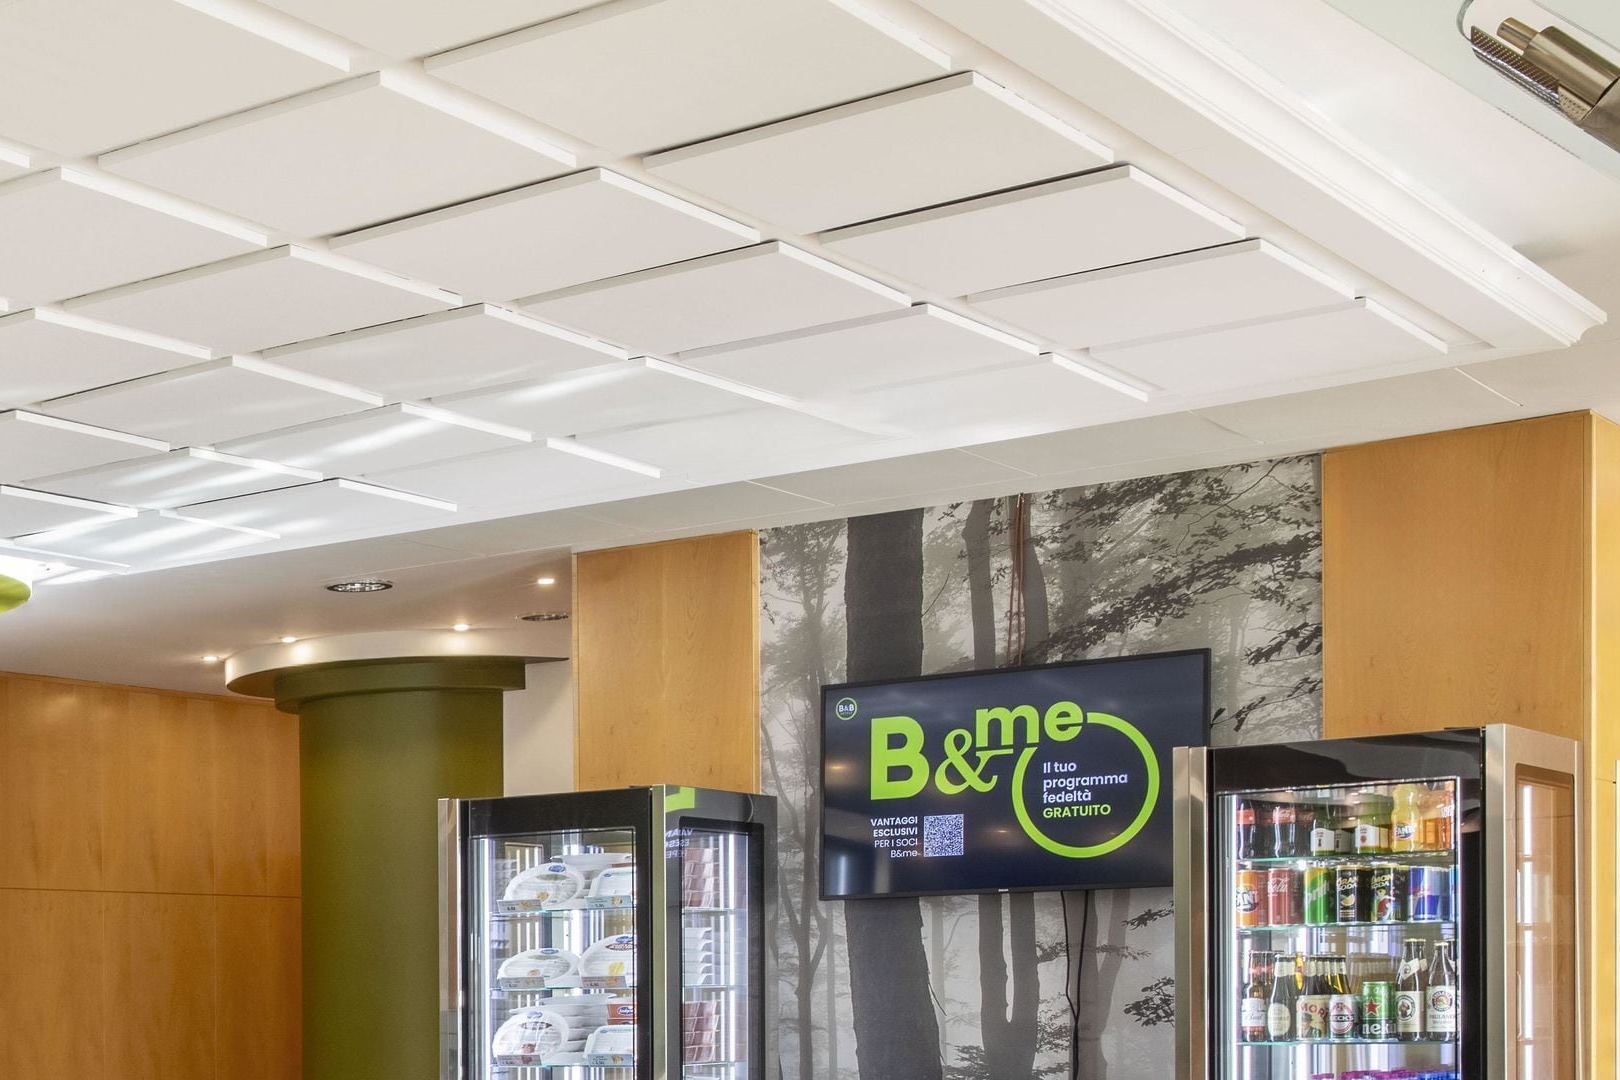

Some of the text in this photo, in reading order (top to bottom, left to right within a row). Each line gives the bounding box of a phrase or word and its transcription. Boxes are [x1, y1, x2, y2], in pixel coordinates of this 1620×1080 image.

[1043, 761, 1077, 774] Il tuo
[1043, 773, 1128, 792] programma
[1043, 789, 1092, 804] fedeltà
[1043, 804, 1112, 819] GRATUITO
[870, 816, 918, 827] VANTAGGI
[873, 827, 918, 838] ESCLUSIVI
[874, 839, 890, 848] PER
[895, 838, 918, 847] SOCI
[890, 849, 918, 859] B&me
